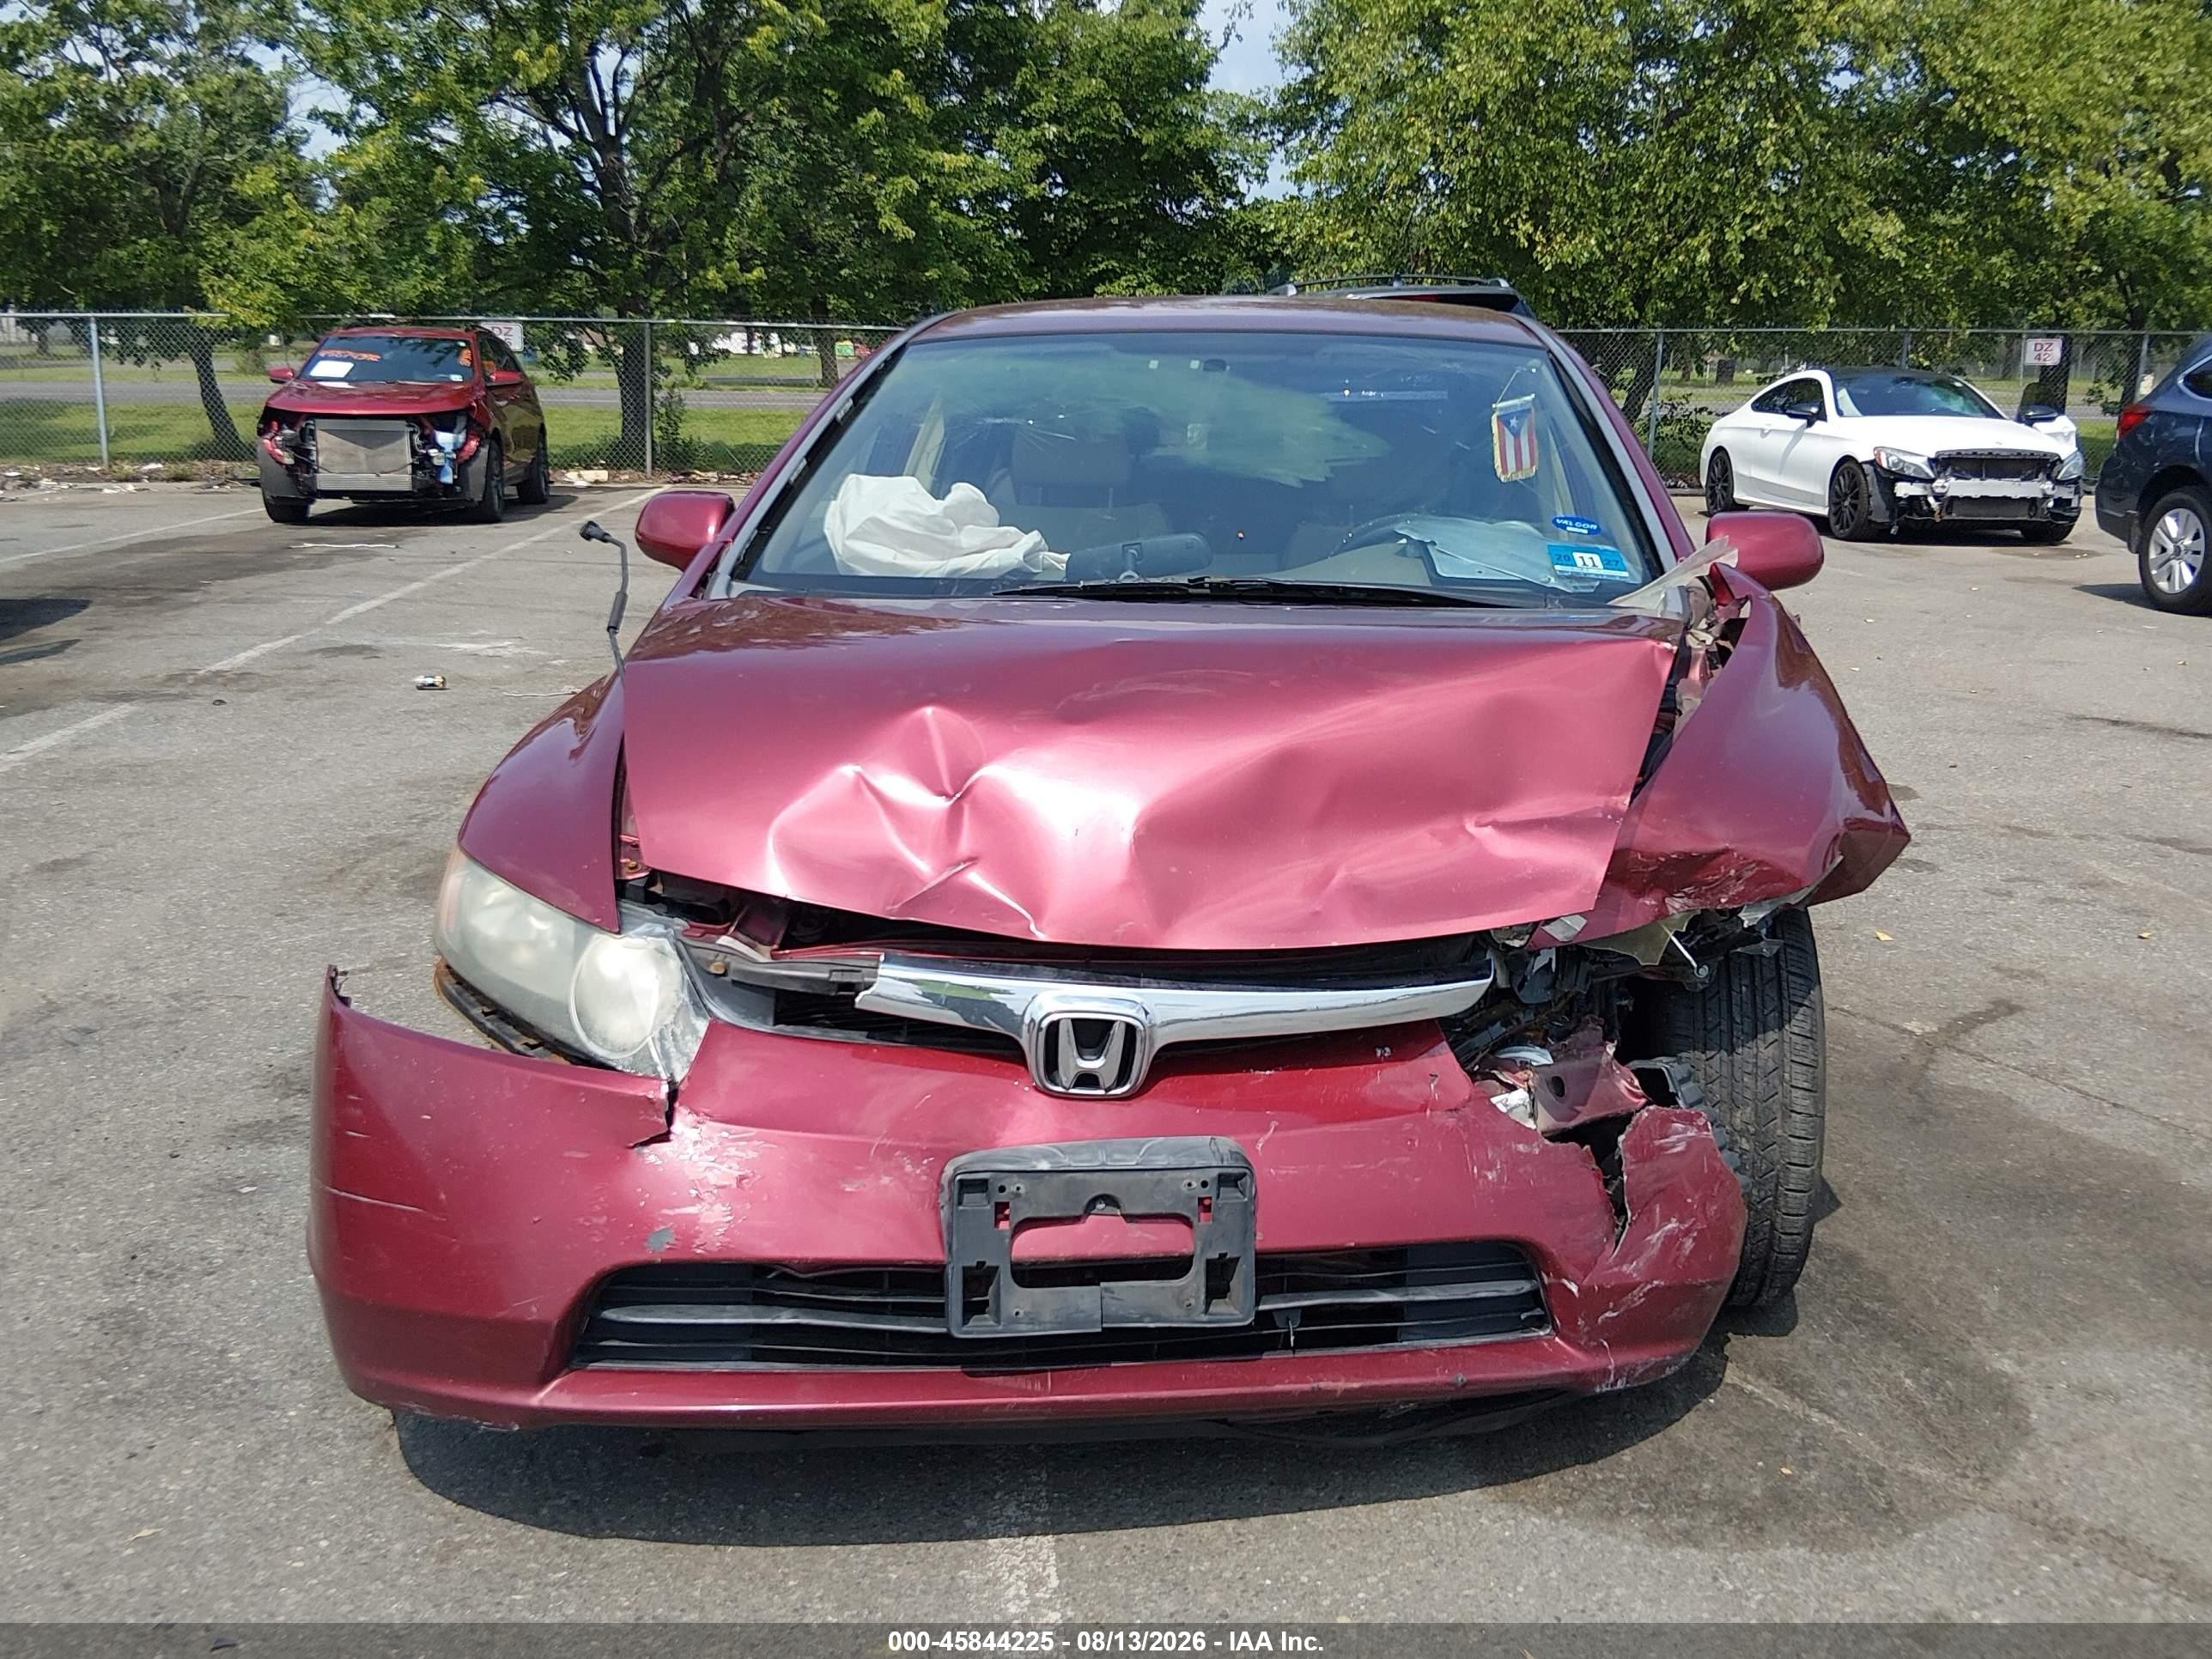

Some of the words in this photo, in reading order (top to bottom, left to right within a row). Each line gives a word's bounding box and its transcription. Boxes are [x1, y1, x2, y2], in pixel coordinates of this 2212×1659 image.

[491, 327, 513, 336] DZ
[2034, 343, 2054, 351] DZ
[2034, 353, 2051, 362] 42
[1555, 554, 1571, 562] 20
[1578, 556, 1599, 568] 11
